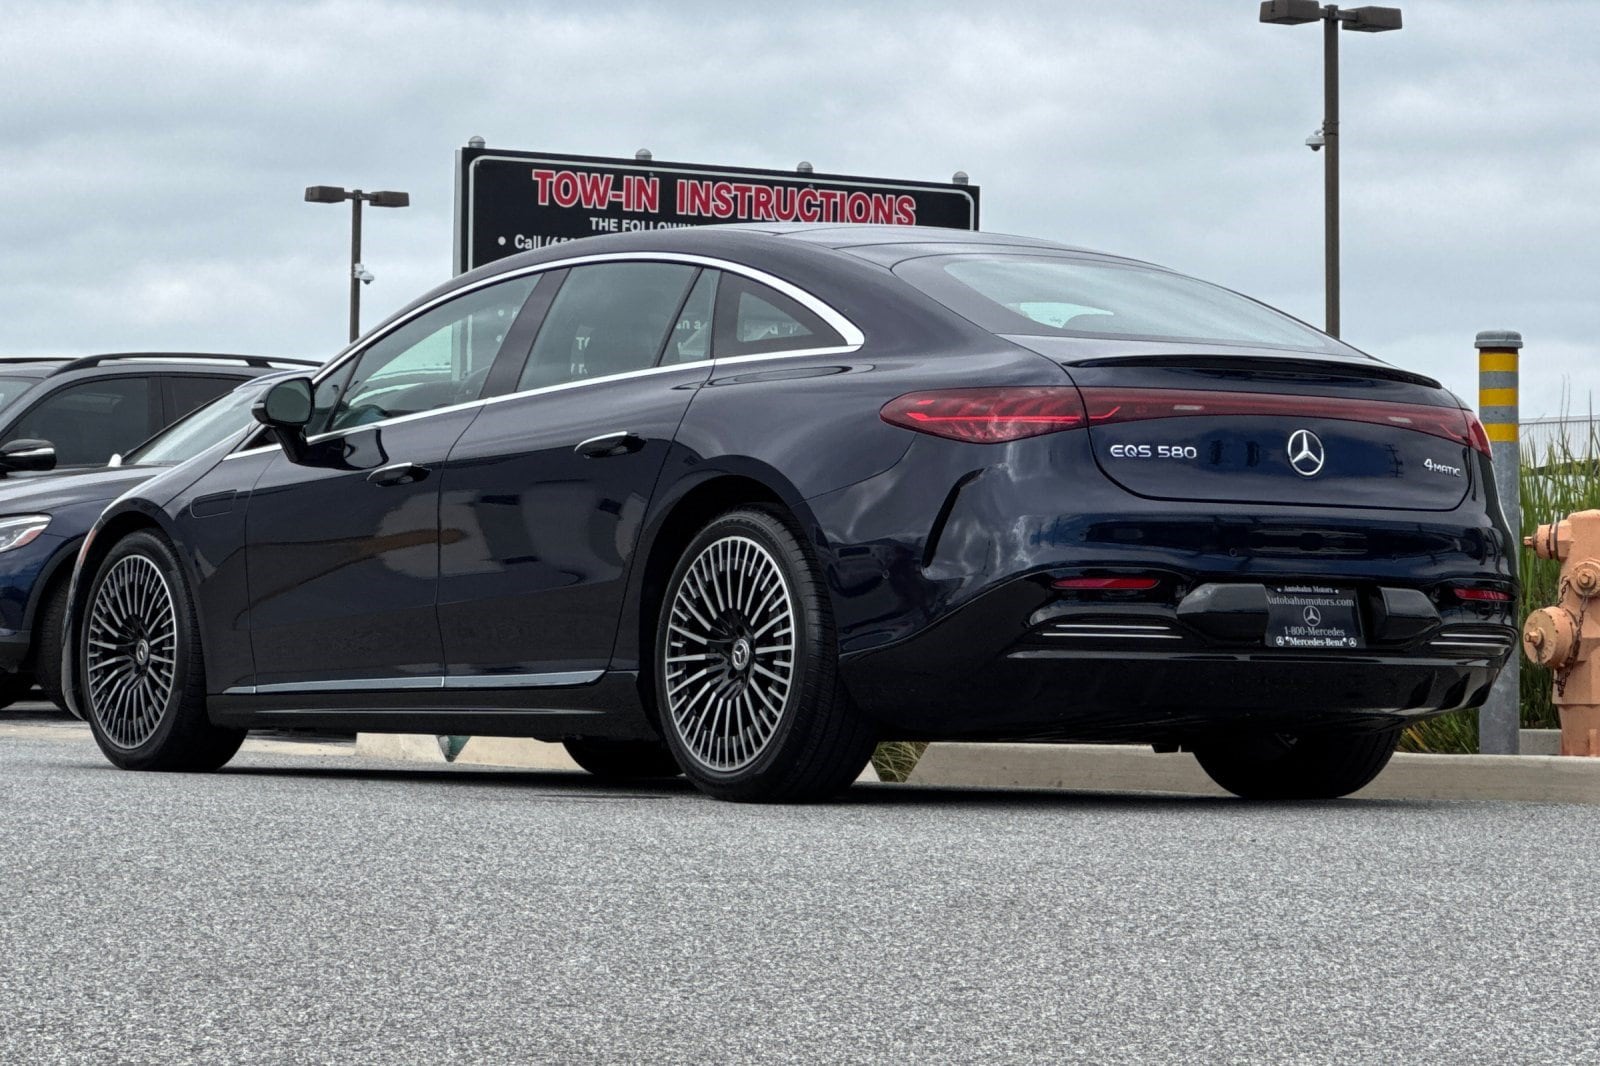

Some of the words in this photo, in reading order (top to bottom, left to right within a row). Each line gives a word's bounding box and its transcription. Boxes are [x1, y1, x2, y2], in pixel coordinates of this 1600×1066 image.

[532, 169, 659, 213] TOW-IN
[676, 178, 917, 226] INSTRUCTIONS
[589, 217, 619, 232] THE
[514, 234, 542, 249] Call
[1109, 444, 1152, 458] EQS
[1157, 445, 1198, 460] 580
[1423, 457, 1462, 477] 4MATIC
[1284, 626, 1346, 637] 1-800-Mercedes
